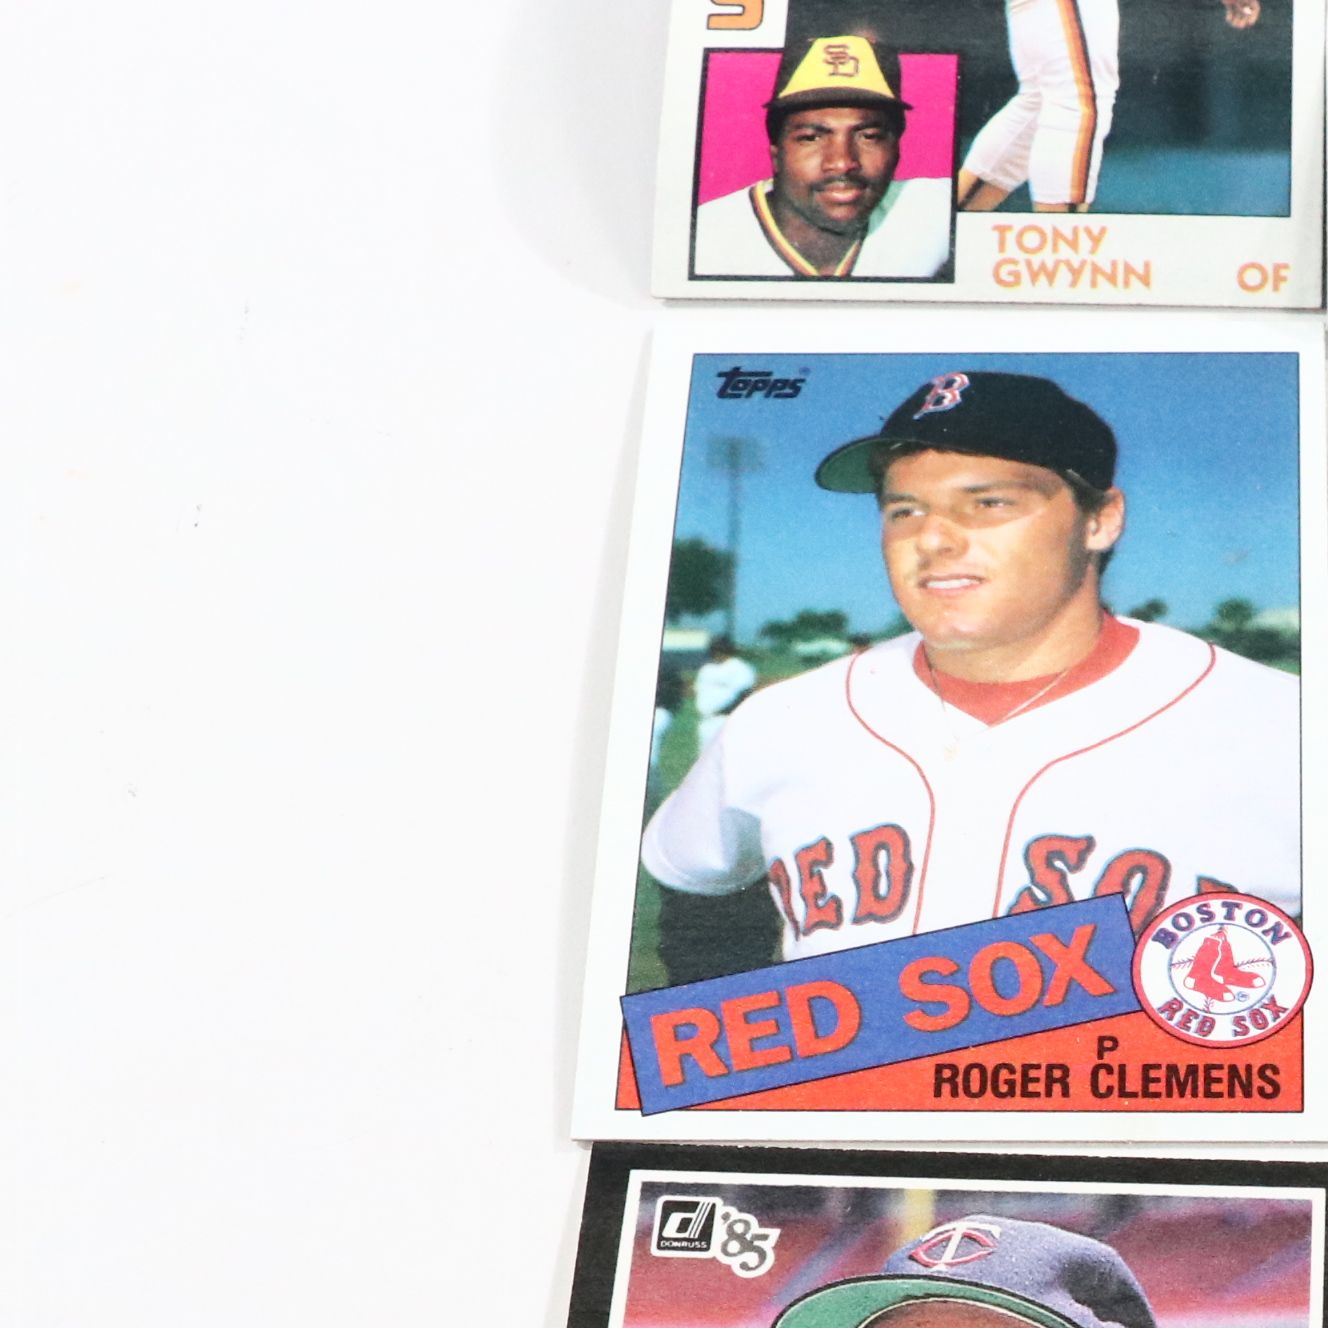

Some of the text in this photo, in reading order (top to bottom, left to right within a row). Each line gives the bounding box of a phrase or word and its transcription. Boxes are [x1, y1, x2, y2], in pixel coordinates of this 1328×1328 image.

[991, 223, 1108, 256] TONY
[991, 260, 1291, 293] GWYNN OF
[912, 372, 972, 421] B
[1151, 900, 1292, 950] BOSTON
[649, 924, 1116, 1088] RED SOX
[1156, 994, 1290, 1038] RED SOX
[1098, 1036, 1119, 1061] P
[932, 1063, 1282, 1099] ROGER CLEMENS
[659, 1239, 709, 1250] DONRUSS
